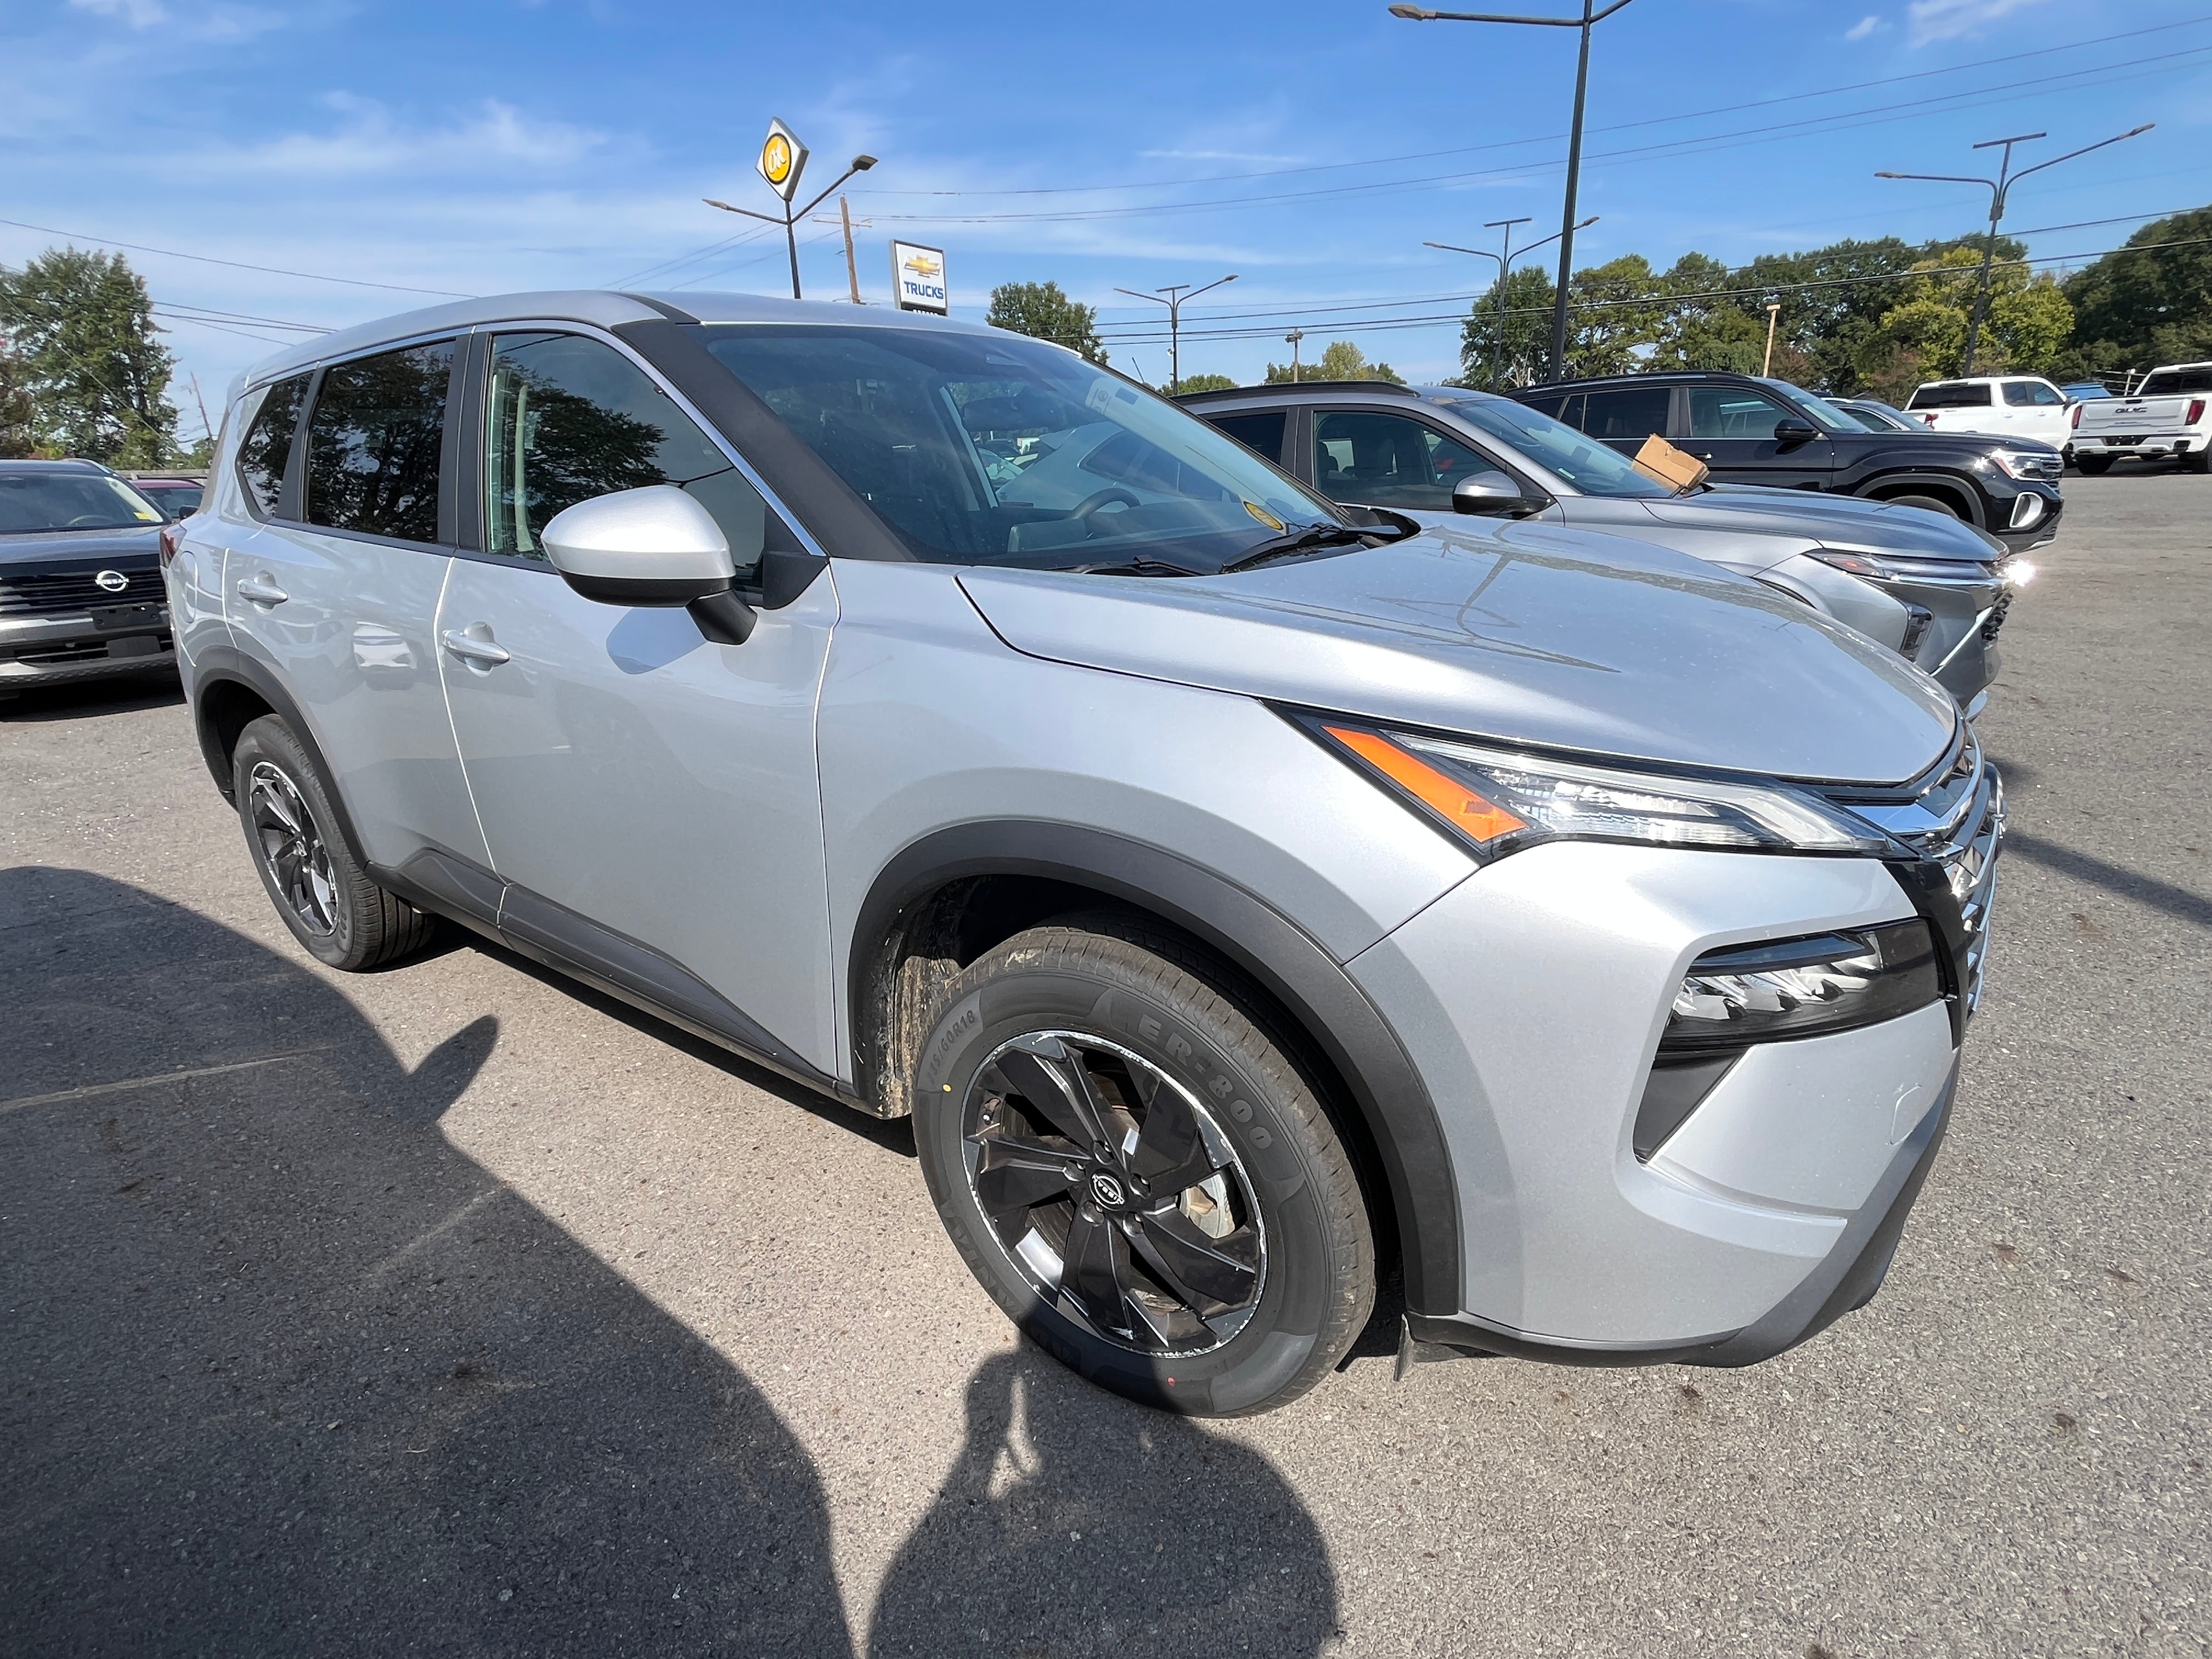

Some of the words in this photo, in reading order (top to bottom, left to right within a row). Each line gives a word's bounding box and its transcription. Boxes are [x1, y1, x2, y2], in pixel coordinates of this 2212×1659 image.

[768, 139, 787, 174] OK
[904, 280, 944, 300] TRUCKS
[1137, 1014, 1272, 1149] ER-800
